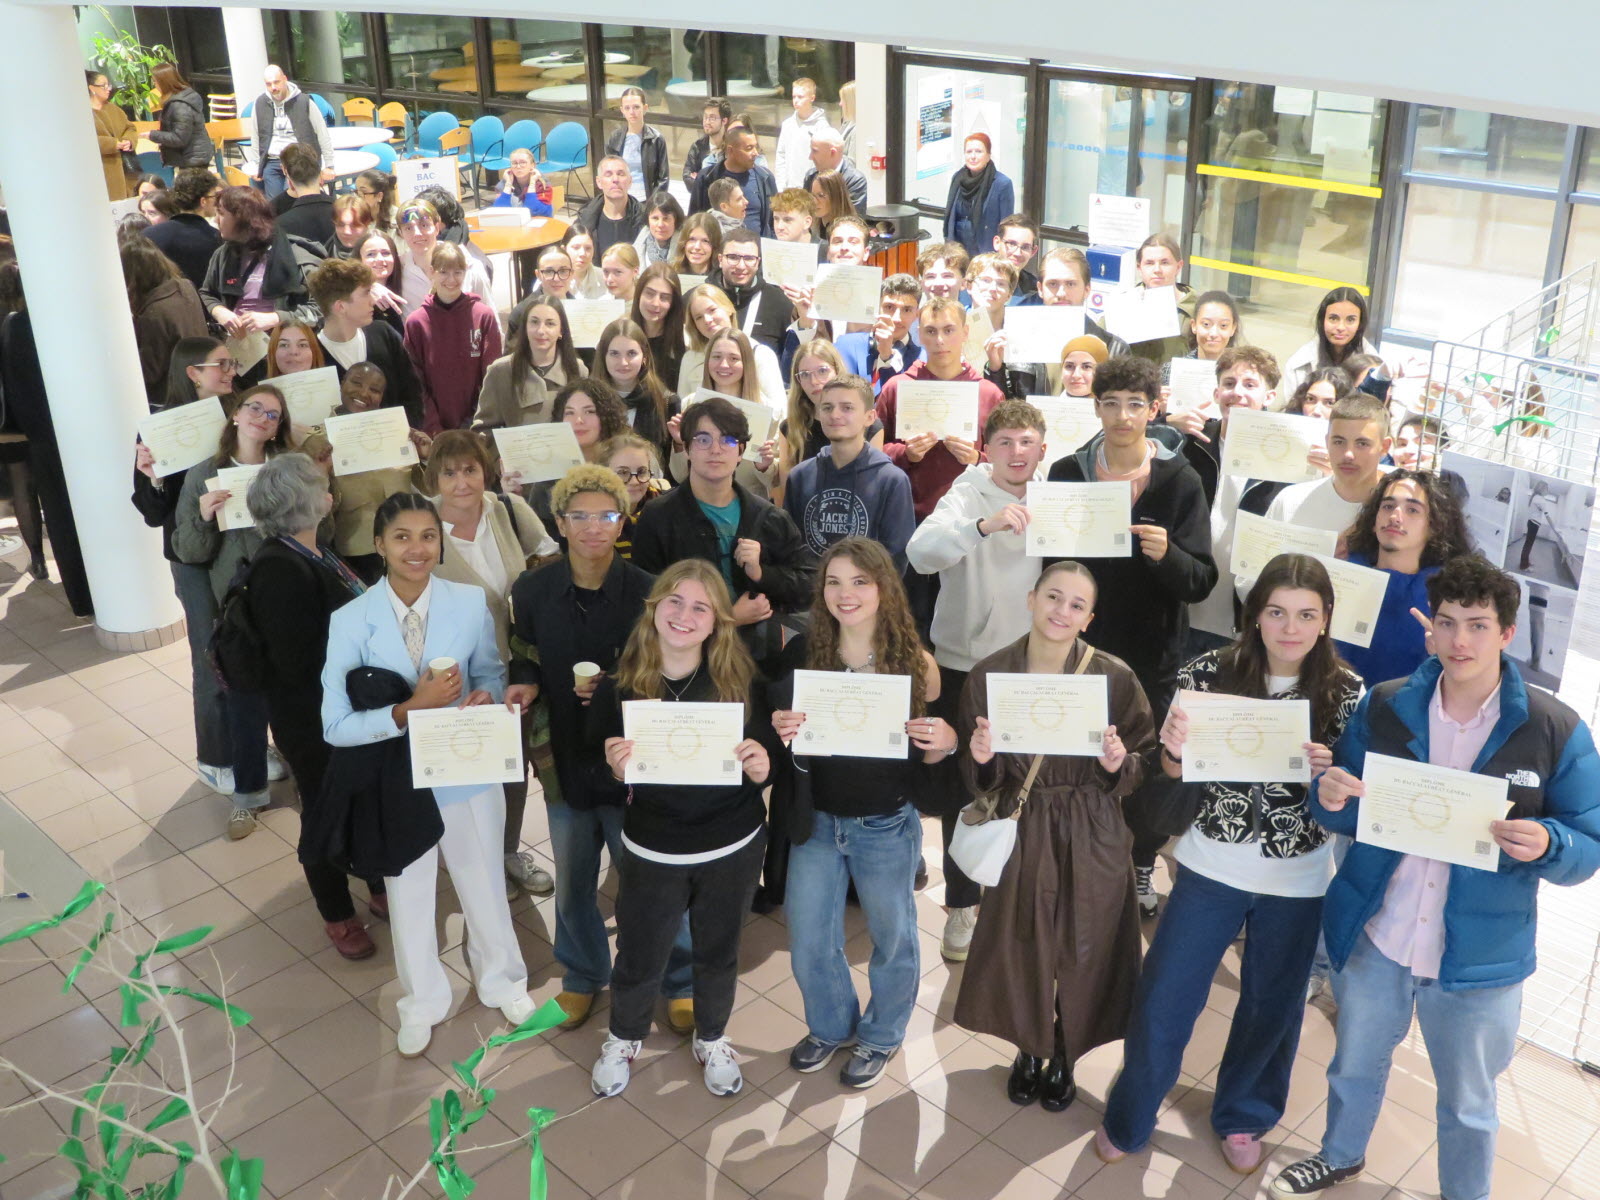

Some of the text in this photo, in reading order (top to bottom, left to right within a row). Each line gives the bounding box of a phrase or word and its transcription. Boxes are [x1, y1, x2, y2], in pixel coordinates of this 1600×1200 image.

[416, 172, 436, 181] BAC
[820, 512, 844, 523] JACK
[819, 523, 849, 534] JONES
[1505, 773, 1529, 781] NORTH
[1511, 778, 1529, 786] FACE
